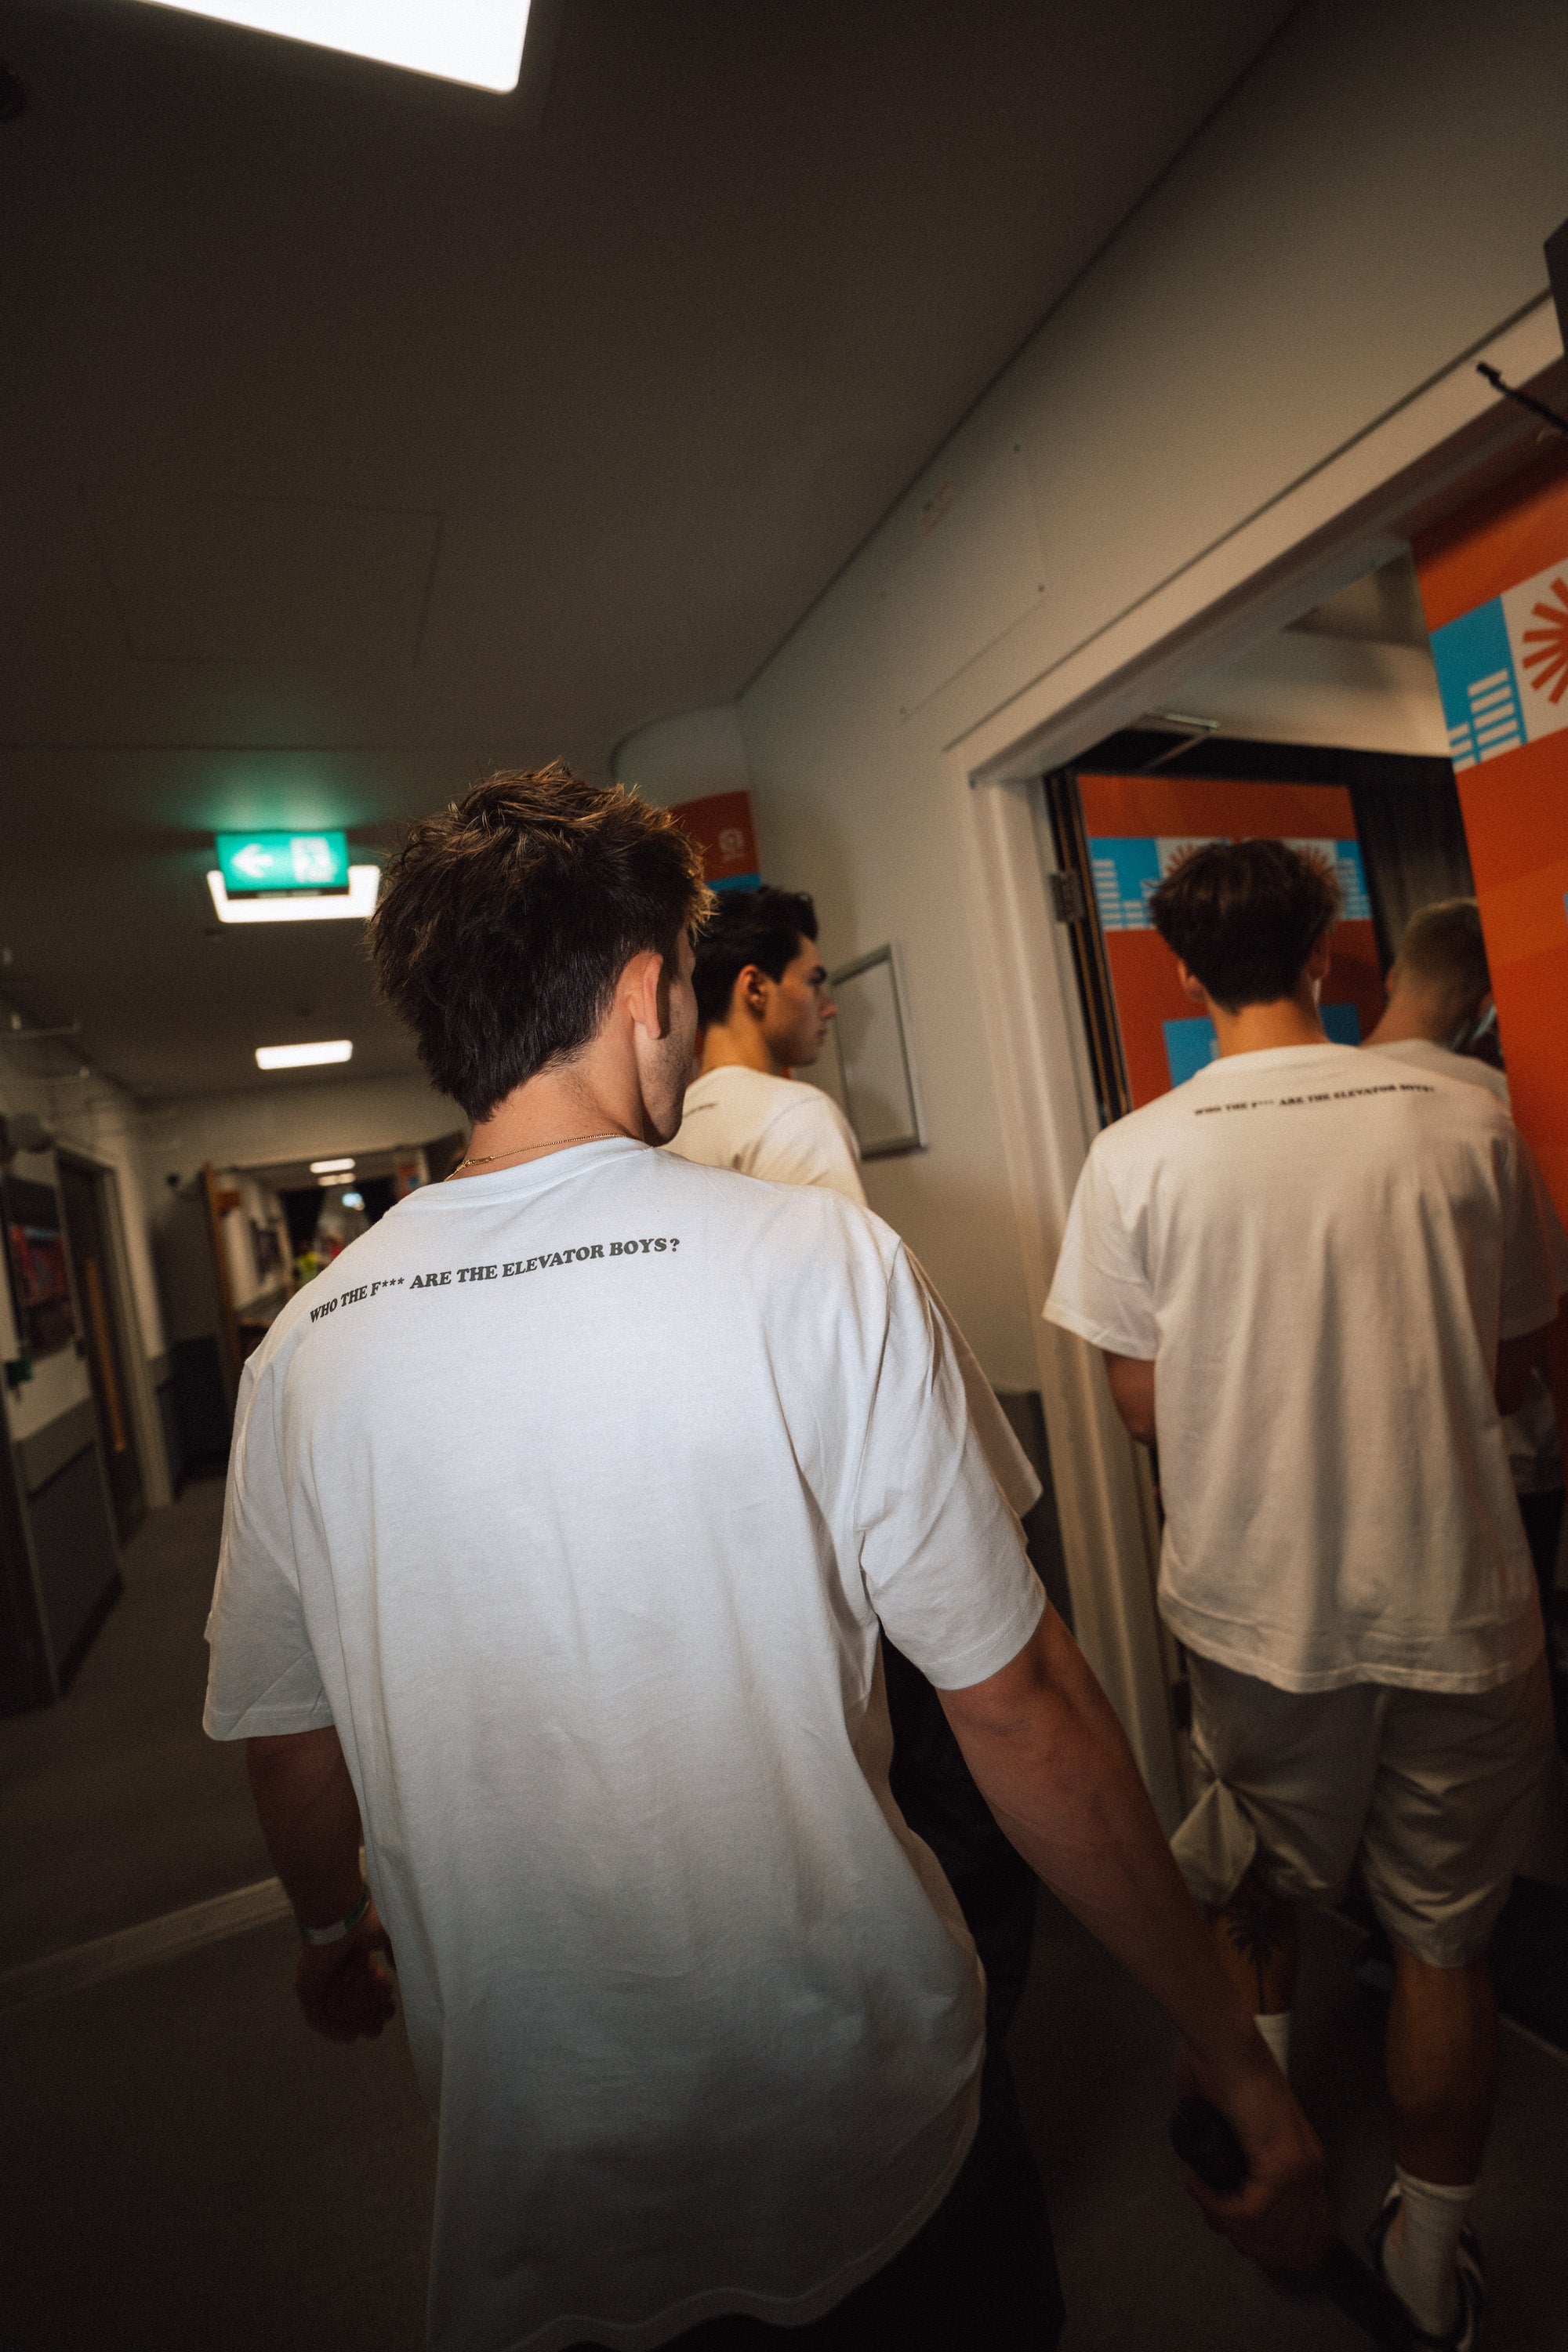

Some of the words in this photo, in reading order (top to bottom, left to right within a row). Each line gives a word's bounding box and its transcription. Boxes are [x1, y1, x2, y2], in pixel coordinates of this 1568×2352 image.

[1279, 1097, 1304, 1106] ARE
[1308, 1093, 1330, 1102] THE
[1334, 1083, 1397, 1099] ELEVATOR
[310, 1298, 338, 1323] WHO
[340, 1286, 367, 1308] THE
[409, 1271, 452, 1290] ARE
[456, 1265, 497, 1283] THE
[502, 1244, 604, 1278] ELEVATOR
[608, 1238, 680, 1257] BOYS?
